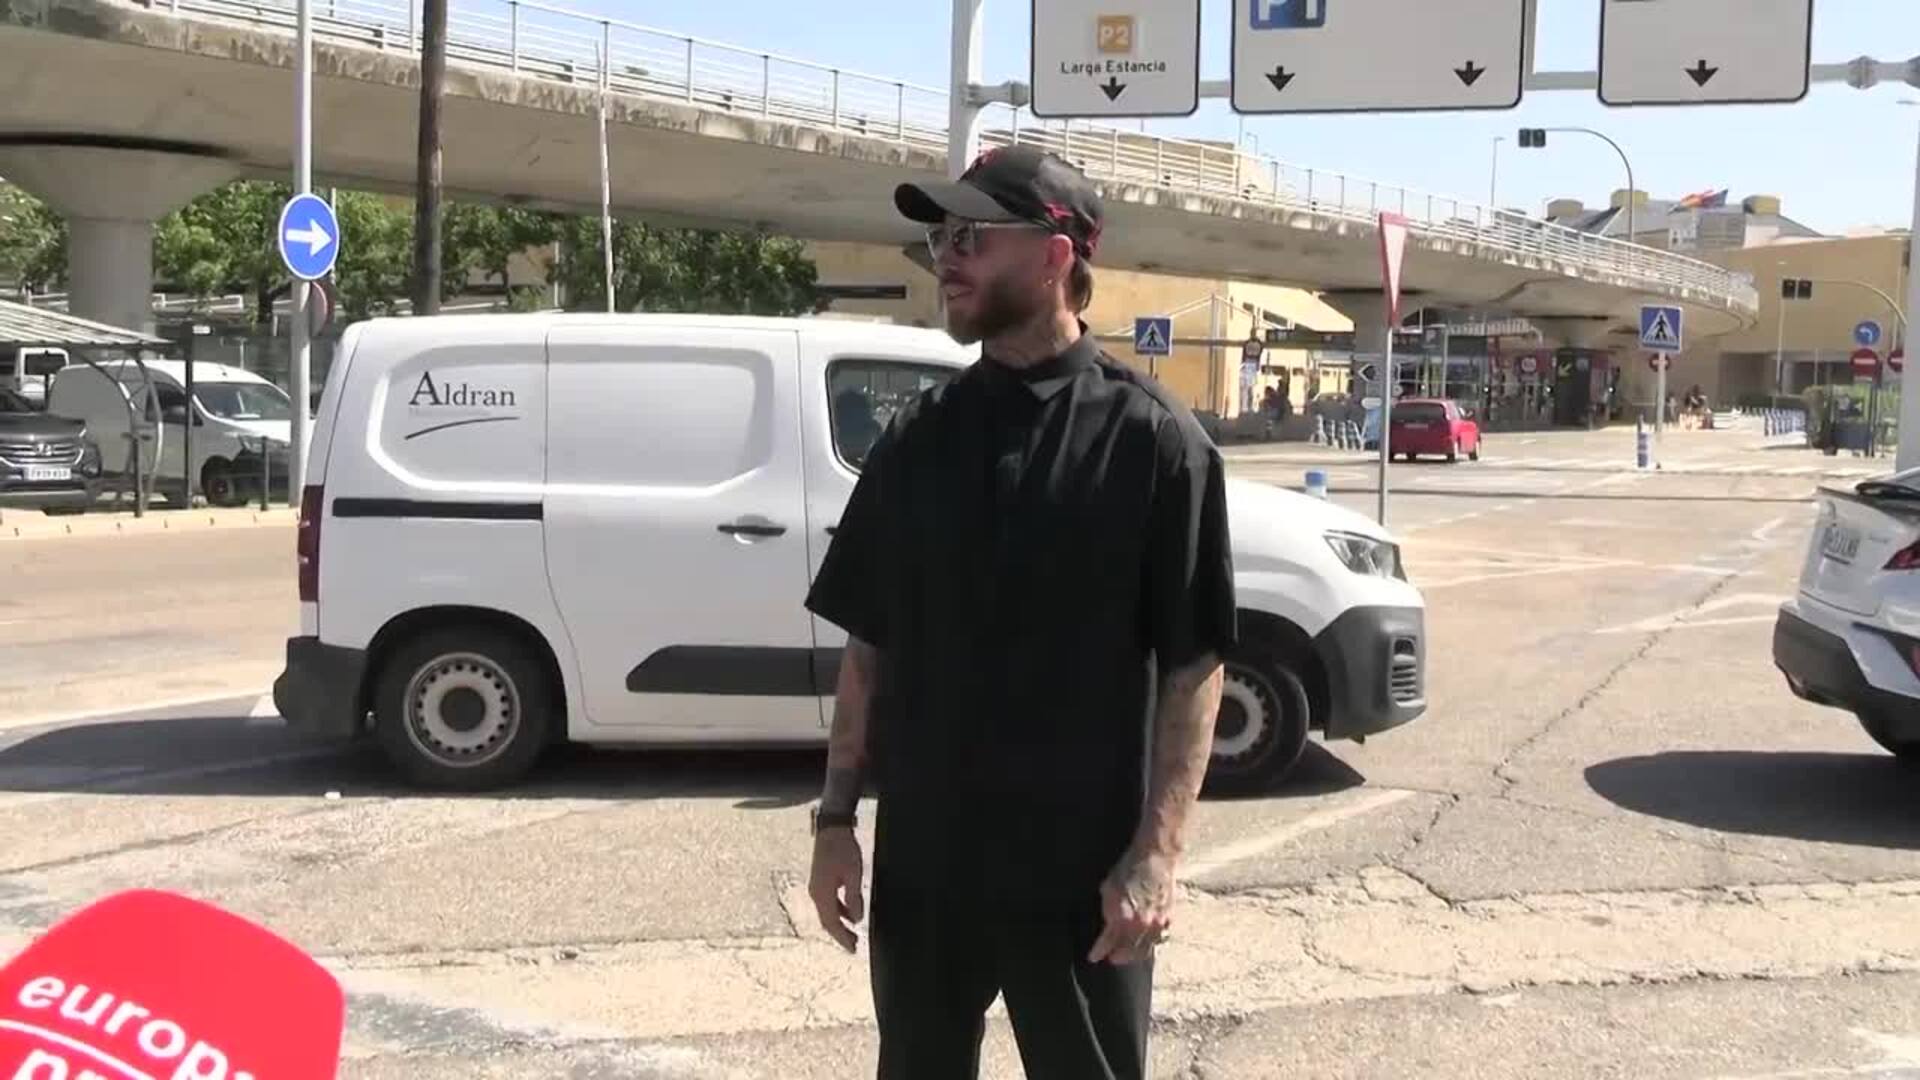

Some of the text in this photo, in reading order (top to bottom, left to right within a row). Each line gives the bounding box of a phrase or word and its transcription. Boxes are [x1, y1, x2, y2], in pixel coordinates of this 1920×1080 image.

[1101, 25, 1129, 46] P2
[1061, 60, 1166, 76] Larga Estancia
[408, 370, 517, 406] Aldran
[18, 976, 256, 1080] europ
